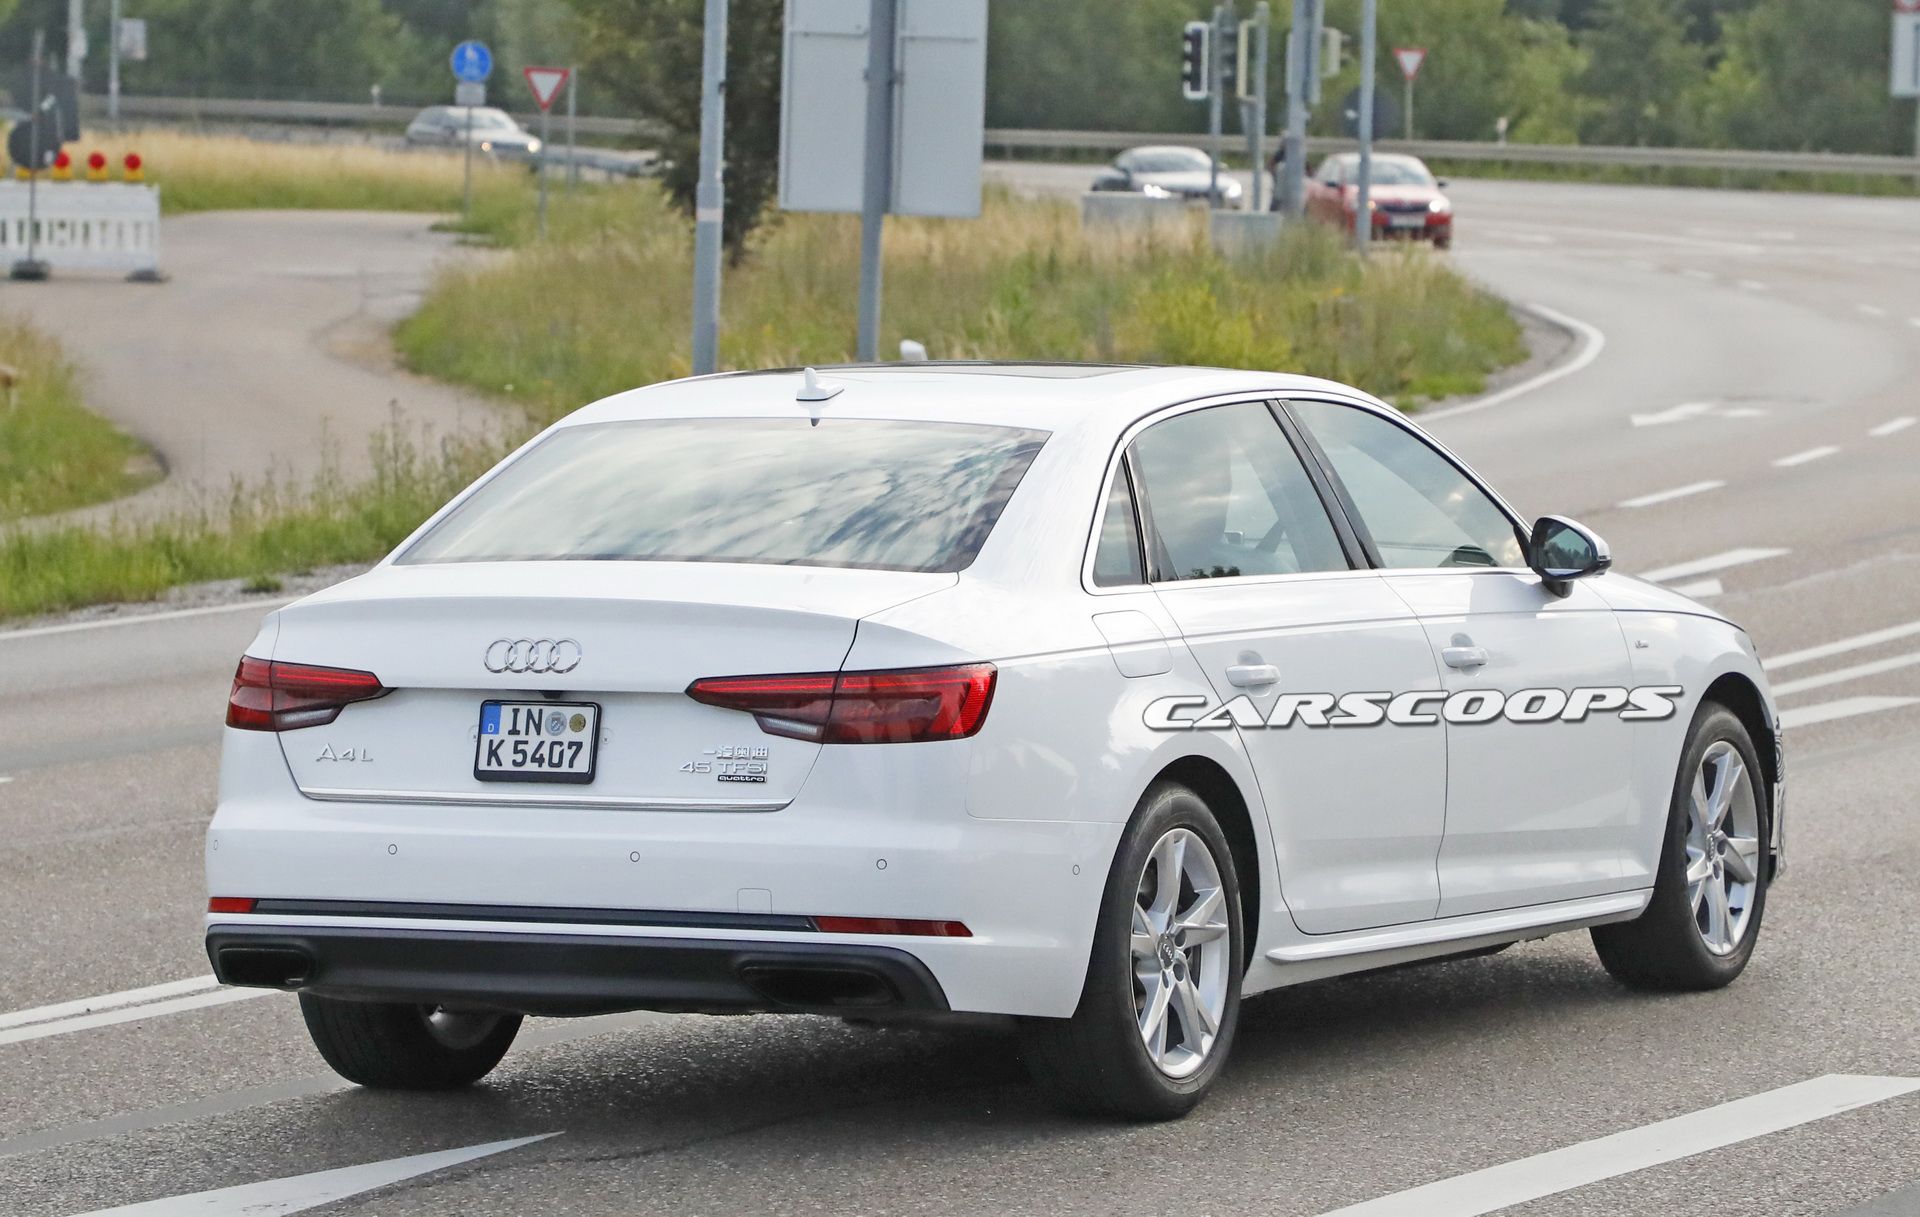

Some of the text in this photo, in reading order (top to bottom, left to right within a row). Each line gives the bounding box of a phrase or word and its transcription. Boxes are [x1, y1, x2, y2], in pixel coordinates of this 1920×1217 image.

[488, 723, 495, 733] D
[508, 708, 543, 736] IN
[486, 739, 583, 768] K 5407
[680, 761, 711, 773] 45
